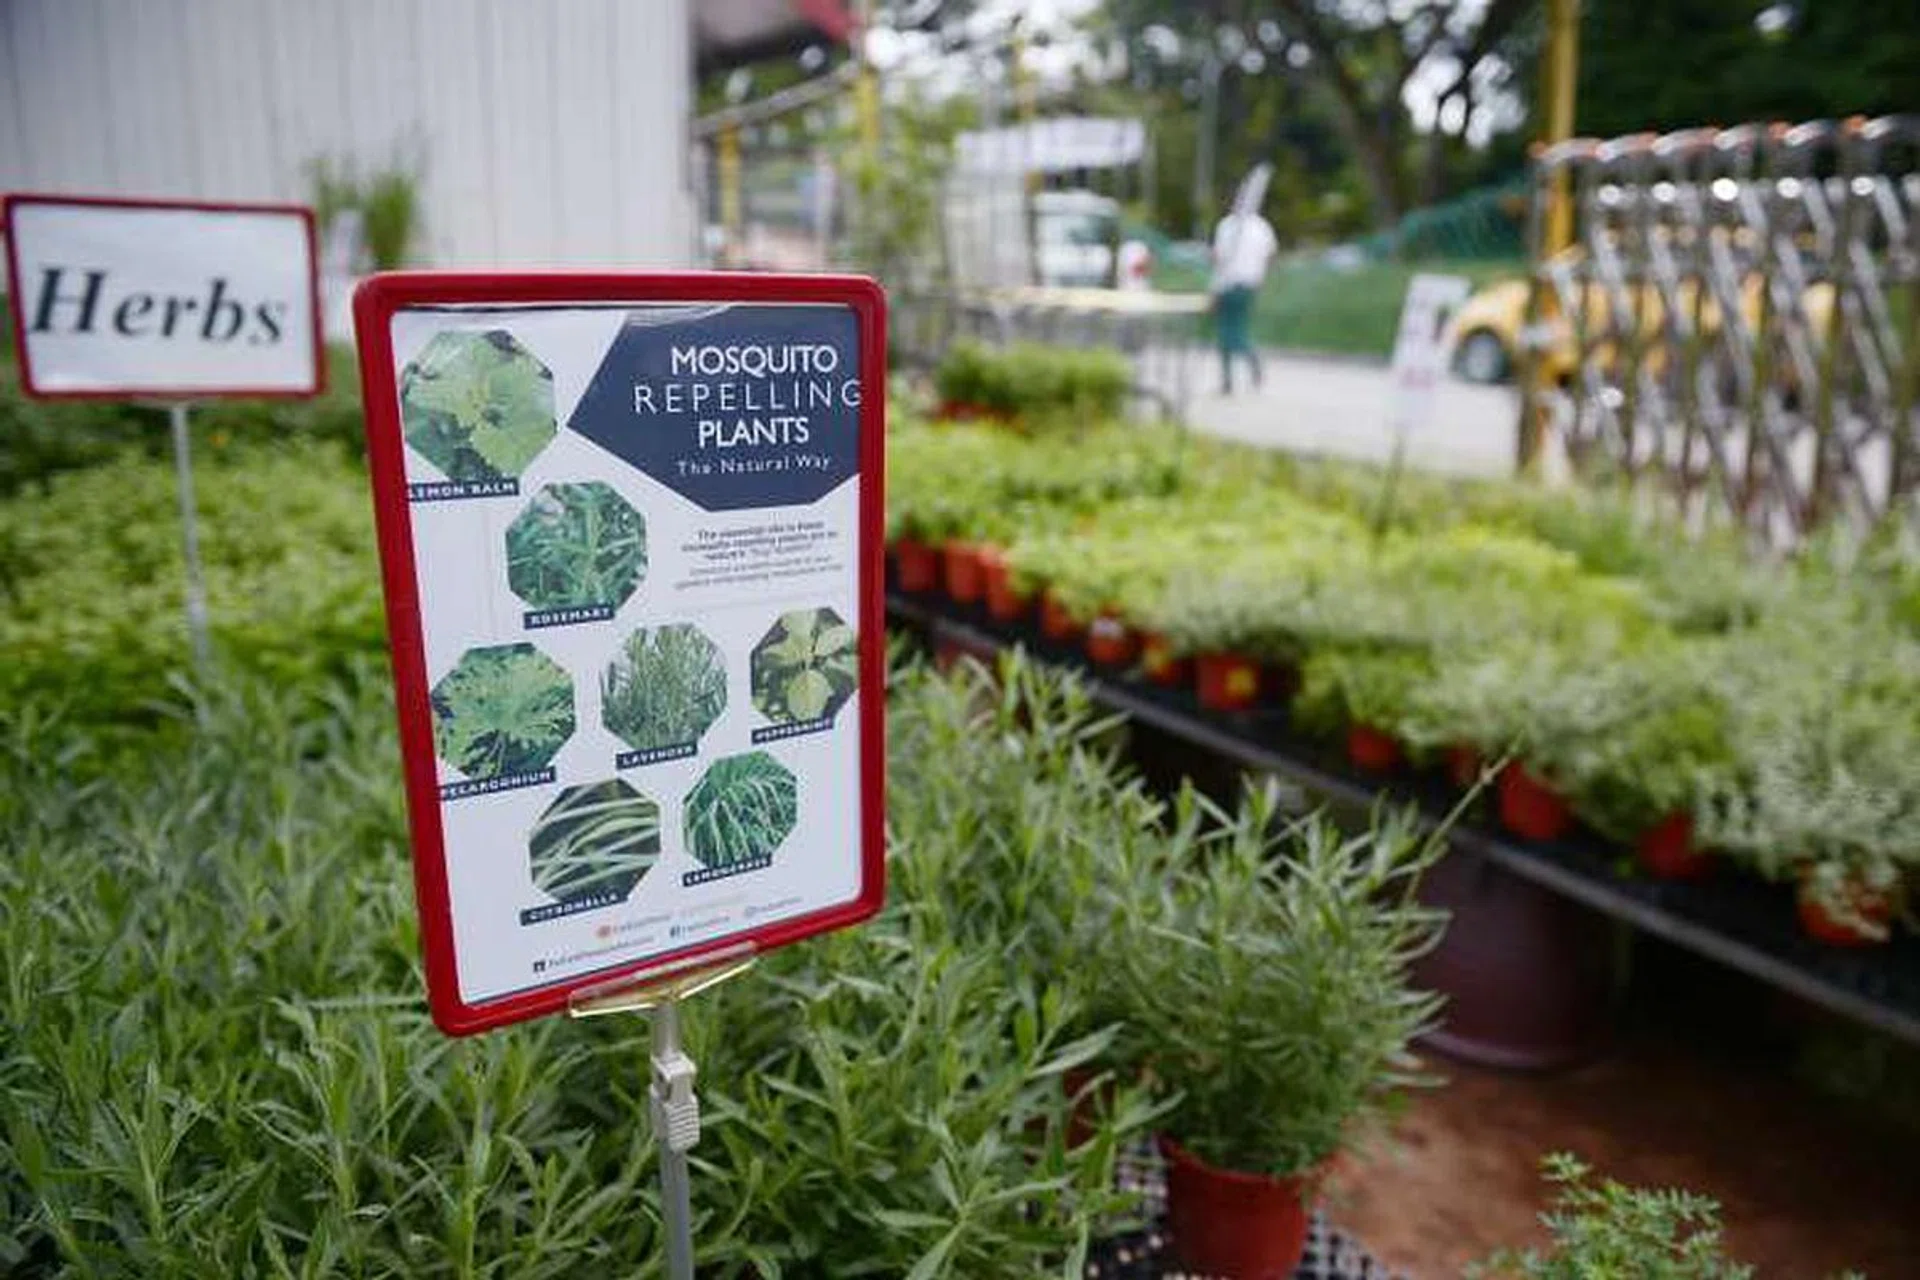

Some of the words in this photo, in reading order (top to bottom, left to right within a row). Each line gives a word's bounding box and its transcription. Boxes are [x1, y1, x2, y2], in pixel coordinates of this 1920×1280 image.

[31, 266, 285, 345] Herbs
[671, 344, 838, 377] MOSQUITO
[633, 379, 862, 414] REPELLING
[698, 417, 810, 449] PLANTS
[677, 461, 711, 476] The
[720, 455, 790, 475] Natural
[796, 453, 830, 470] Way
[471, 482, 515, 495] BALM
